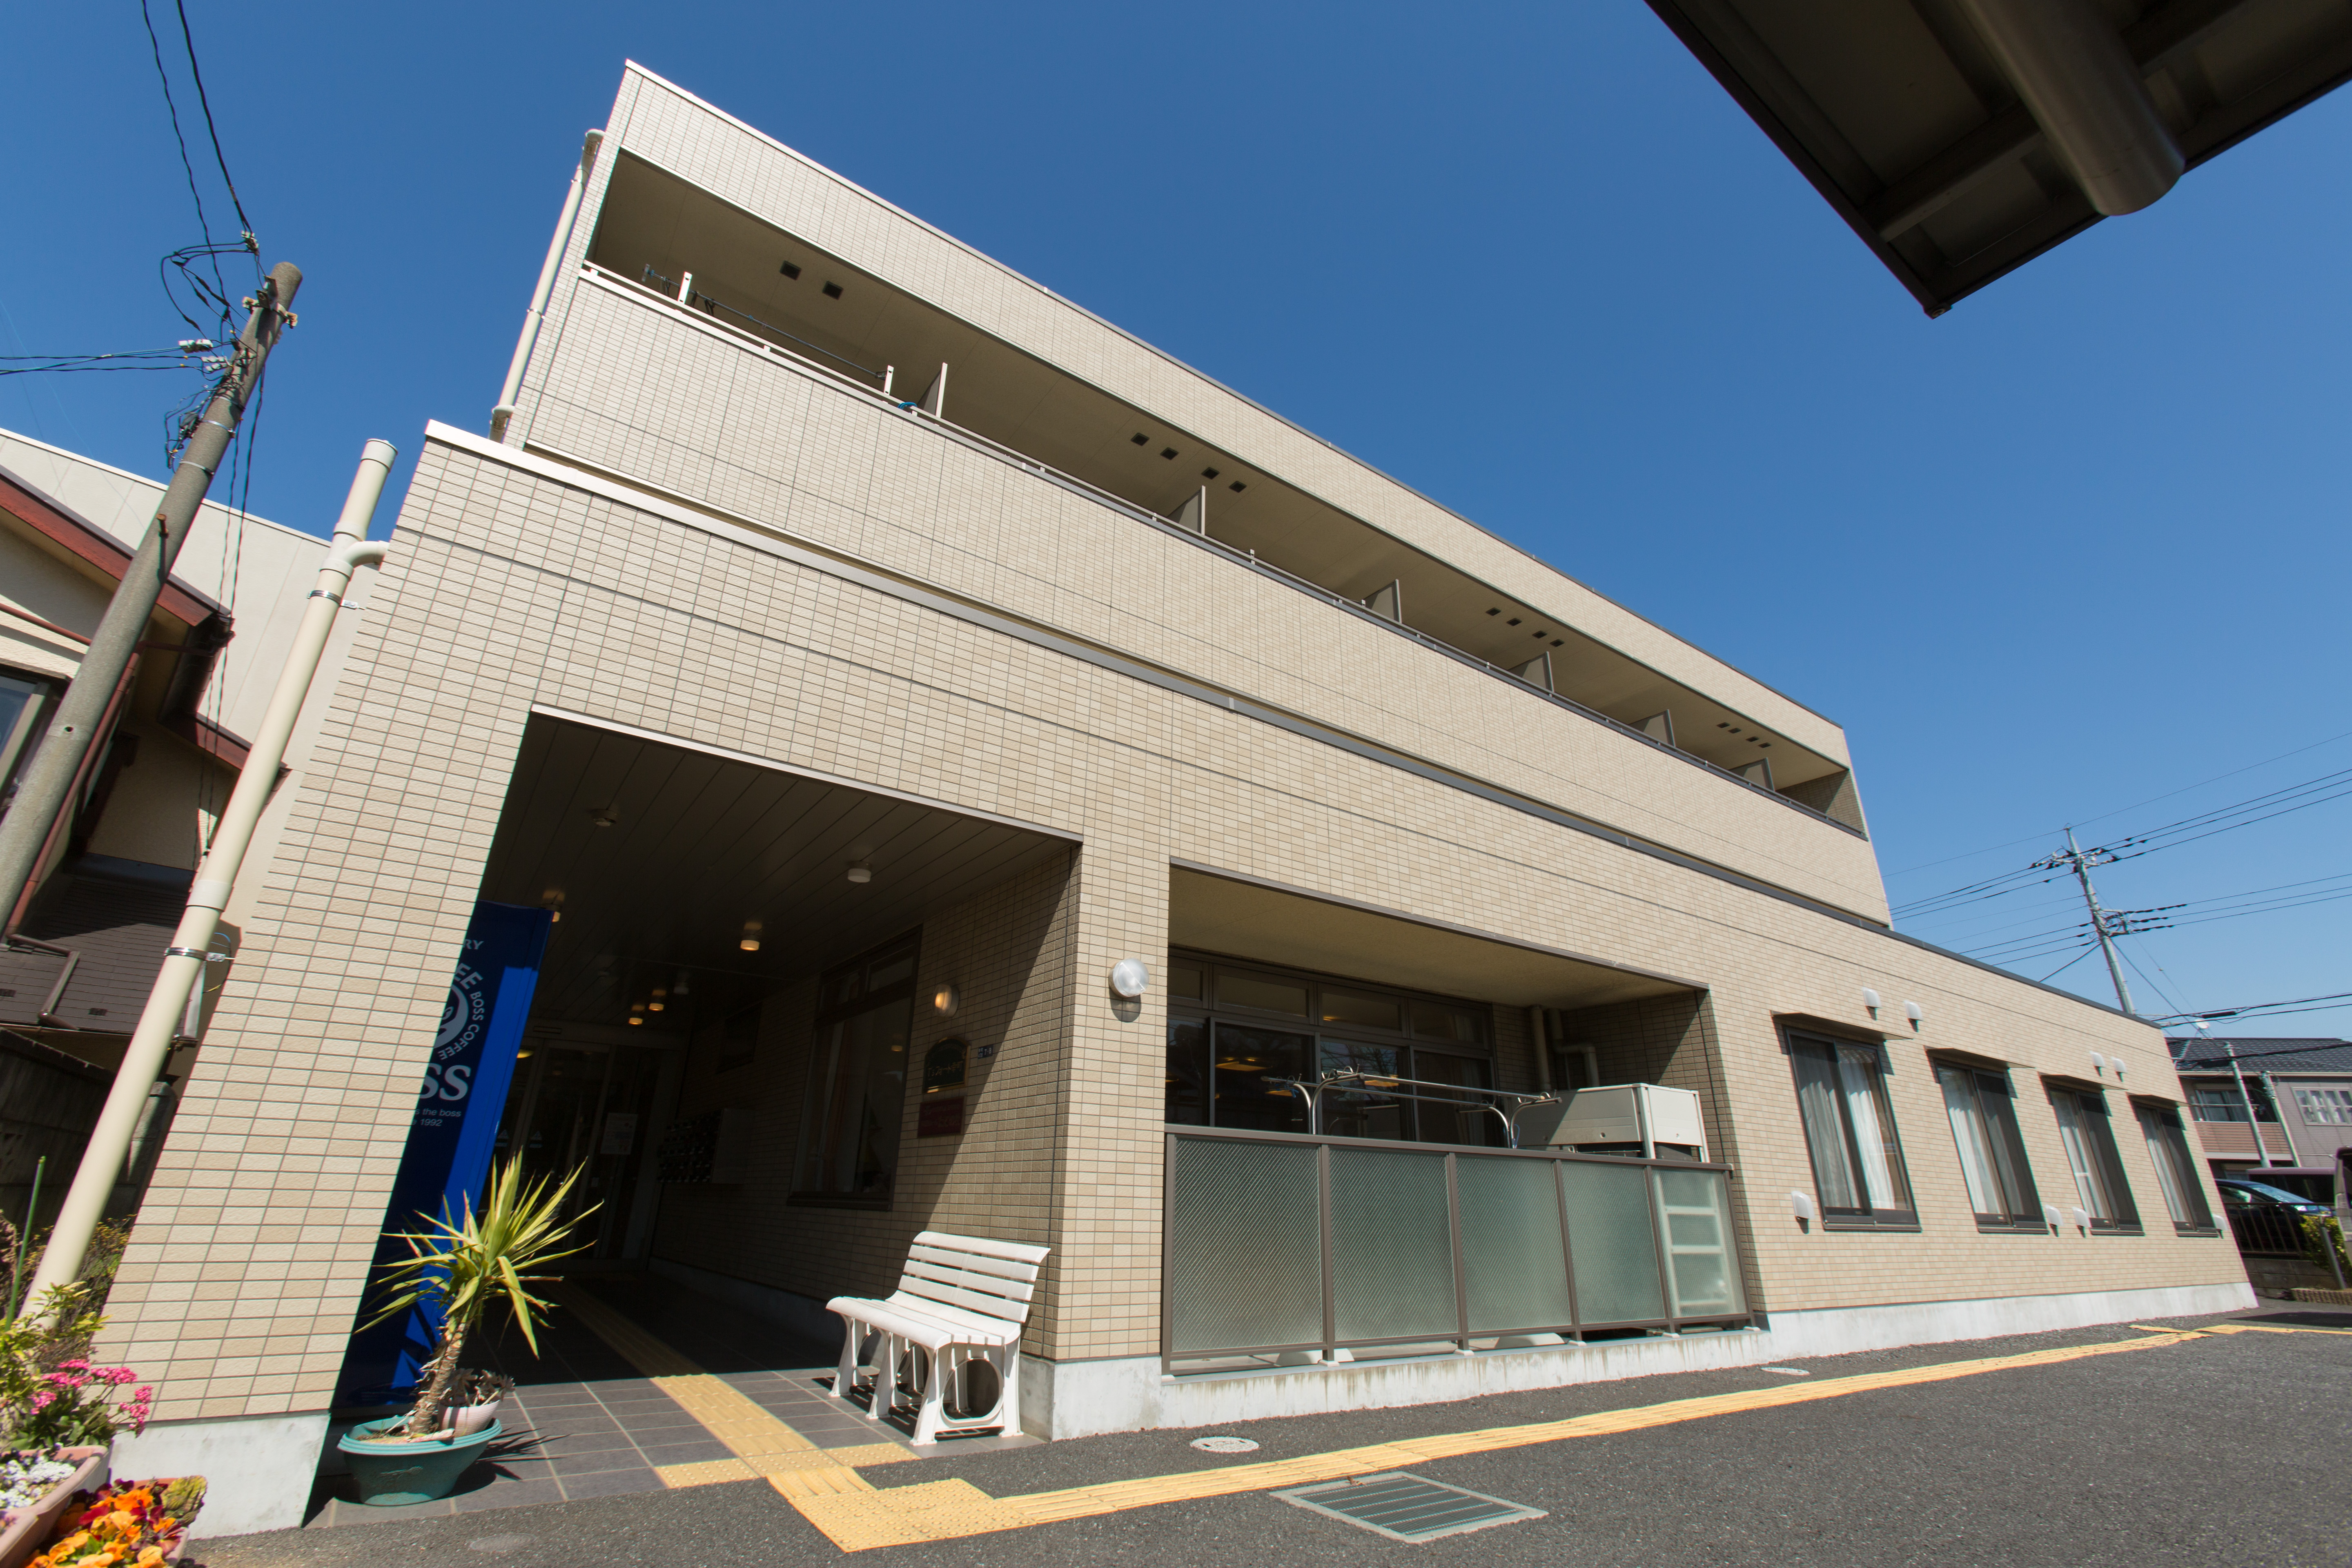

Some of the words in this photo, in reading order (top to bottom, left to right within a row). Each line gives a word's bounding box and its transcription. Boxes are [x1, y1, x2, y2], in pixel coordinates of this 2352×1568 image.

[470, 991, 486, 1021] BOSS
[437, 1024, 480, 1060] COFFEE
[439, 1108, 462, 1117] boss
